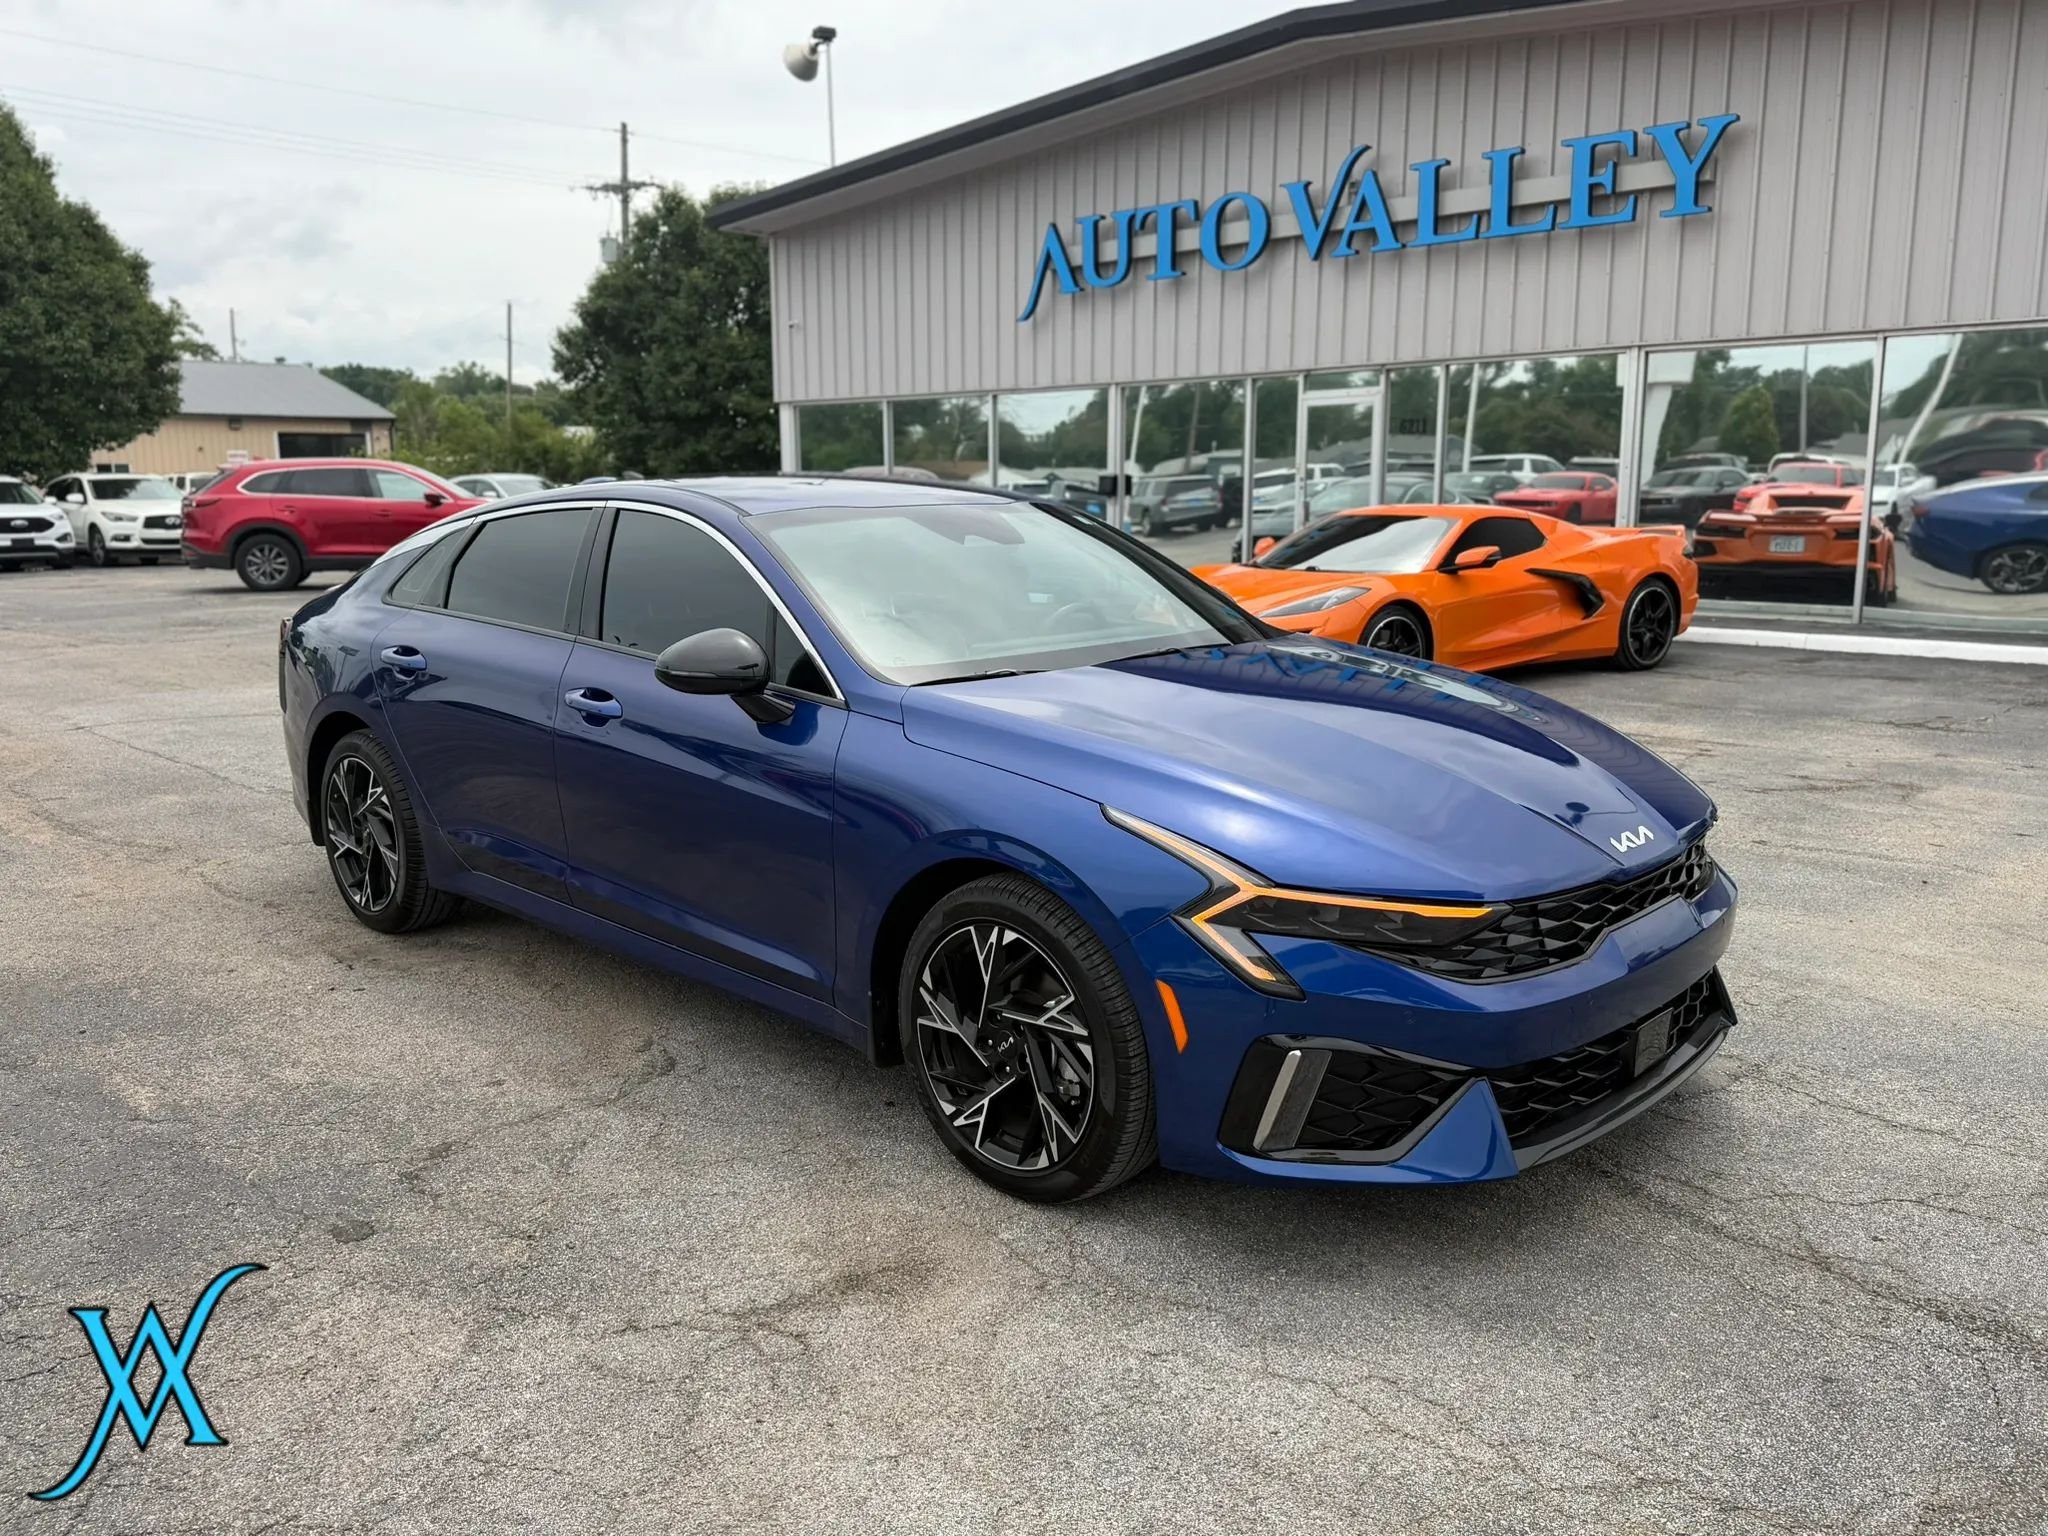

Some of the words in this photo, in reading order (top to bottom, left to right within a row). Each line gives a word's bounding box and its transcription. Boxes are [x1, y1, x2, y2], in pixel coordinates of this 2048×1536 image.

[1017, 190, 1272, 321] AUTO
[1280, 113, 1740, 262] VALLEY
[1609, 825, 1654, 853] KIA
